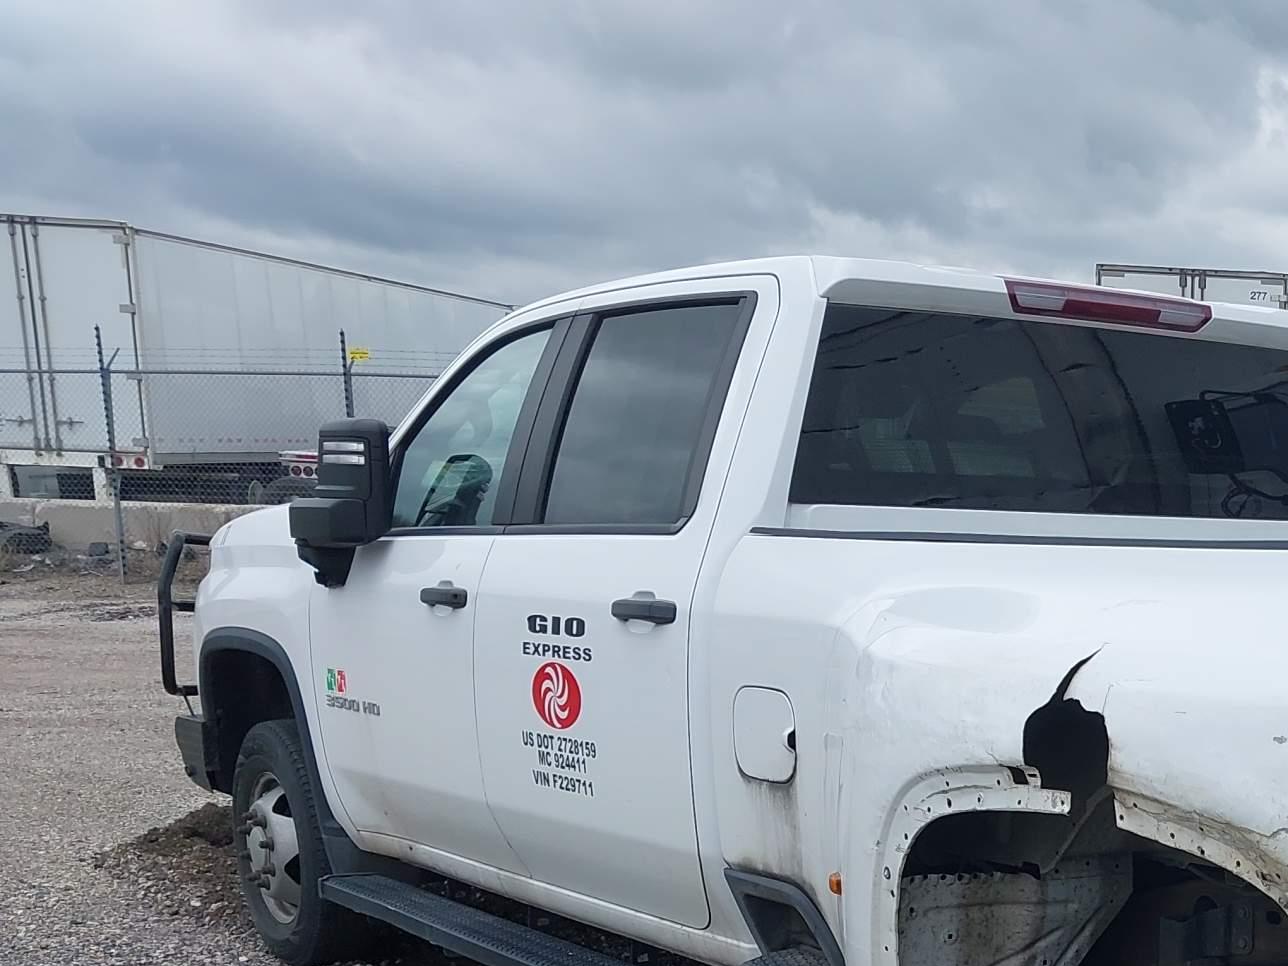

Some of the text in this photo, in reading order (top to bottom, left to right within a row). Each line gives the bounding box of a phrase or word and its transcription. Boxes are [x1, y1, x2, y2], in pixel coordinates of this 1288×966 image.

[1250, 291, 1268, 301] 277
[526, 614, 586, 638] GIO
[522, 641, 593, 662] EXPRESS
[521, 730, 597, 759] US DOT 2728159
[538, 750, 587, 774] MC 924411
[532, 769, 594, 797] VIN F229711
